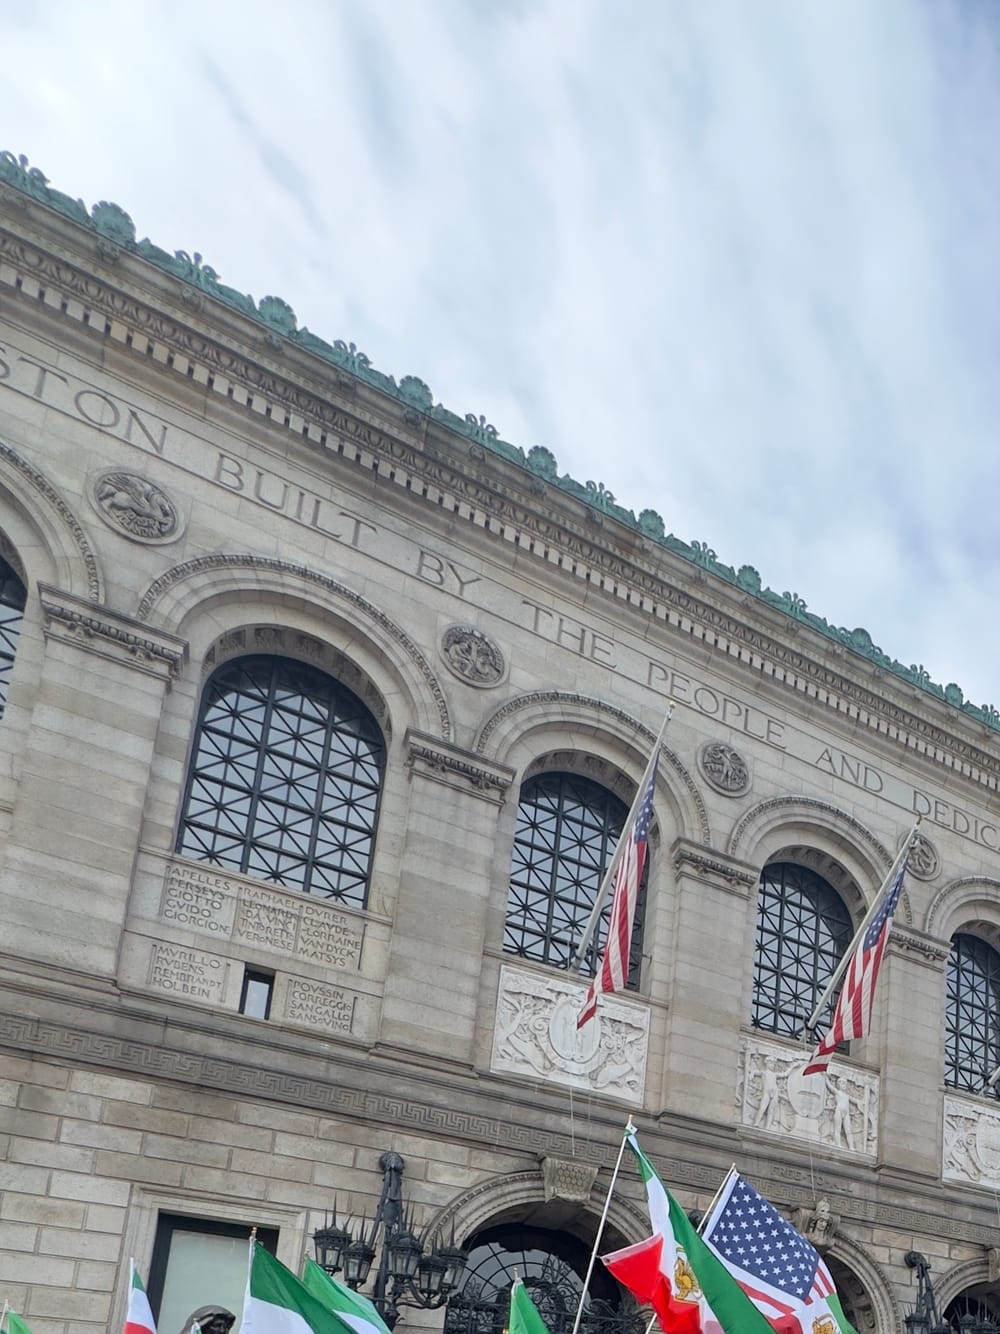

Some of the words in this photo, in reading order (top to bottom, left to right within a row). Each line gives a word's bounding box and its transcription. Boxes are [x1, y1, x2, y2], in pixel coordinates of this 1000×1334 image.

[215, 452, 377, 548] BUILT
[417, 549, 481, 598] BY
[523, 600, 616, 669] THE
[648, 661, 786, 749] PEOPLE
[815, 748, 884, 793] AND
[172, 867, 230, 891] APELLES
[168, 888, 222, 910] GIOTTO
[243, 888, 299, 910] RAPHAEL
[305, 907, 347, 925] DVRER
[156, 957, 205, 976] RVBENS
[158, 946, 220, 969] MVRILLO
[152, 977, 210, 998] HOLBEIN
